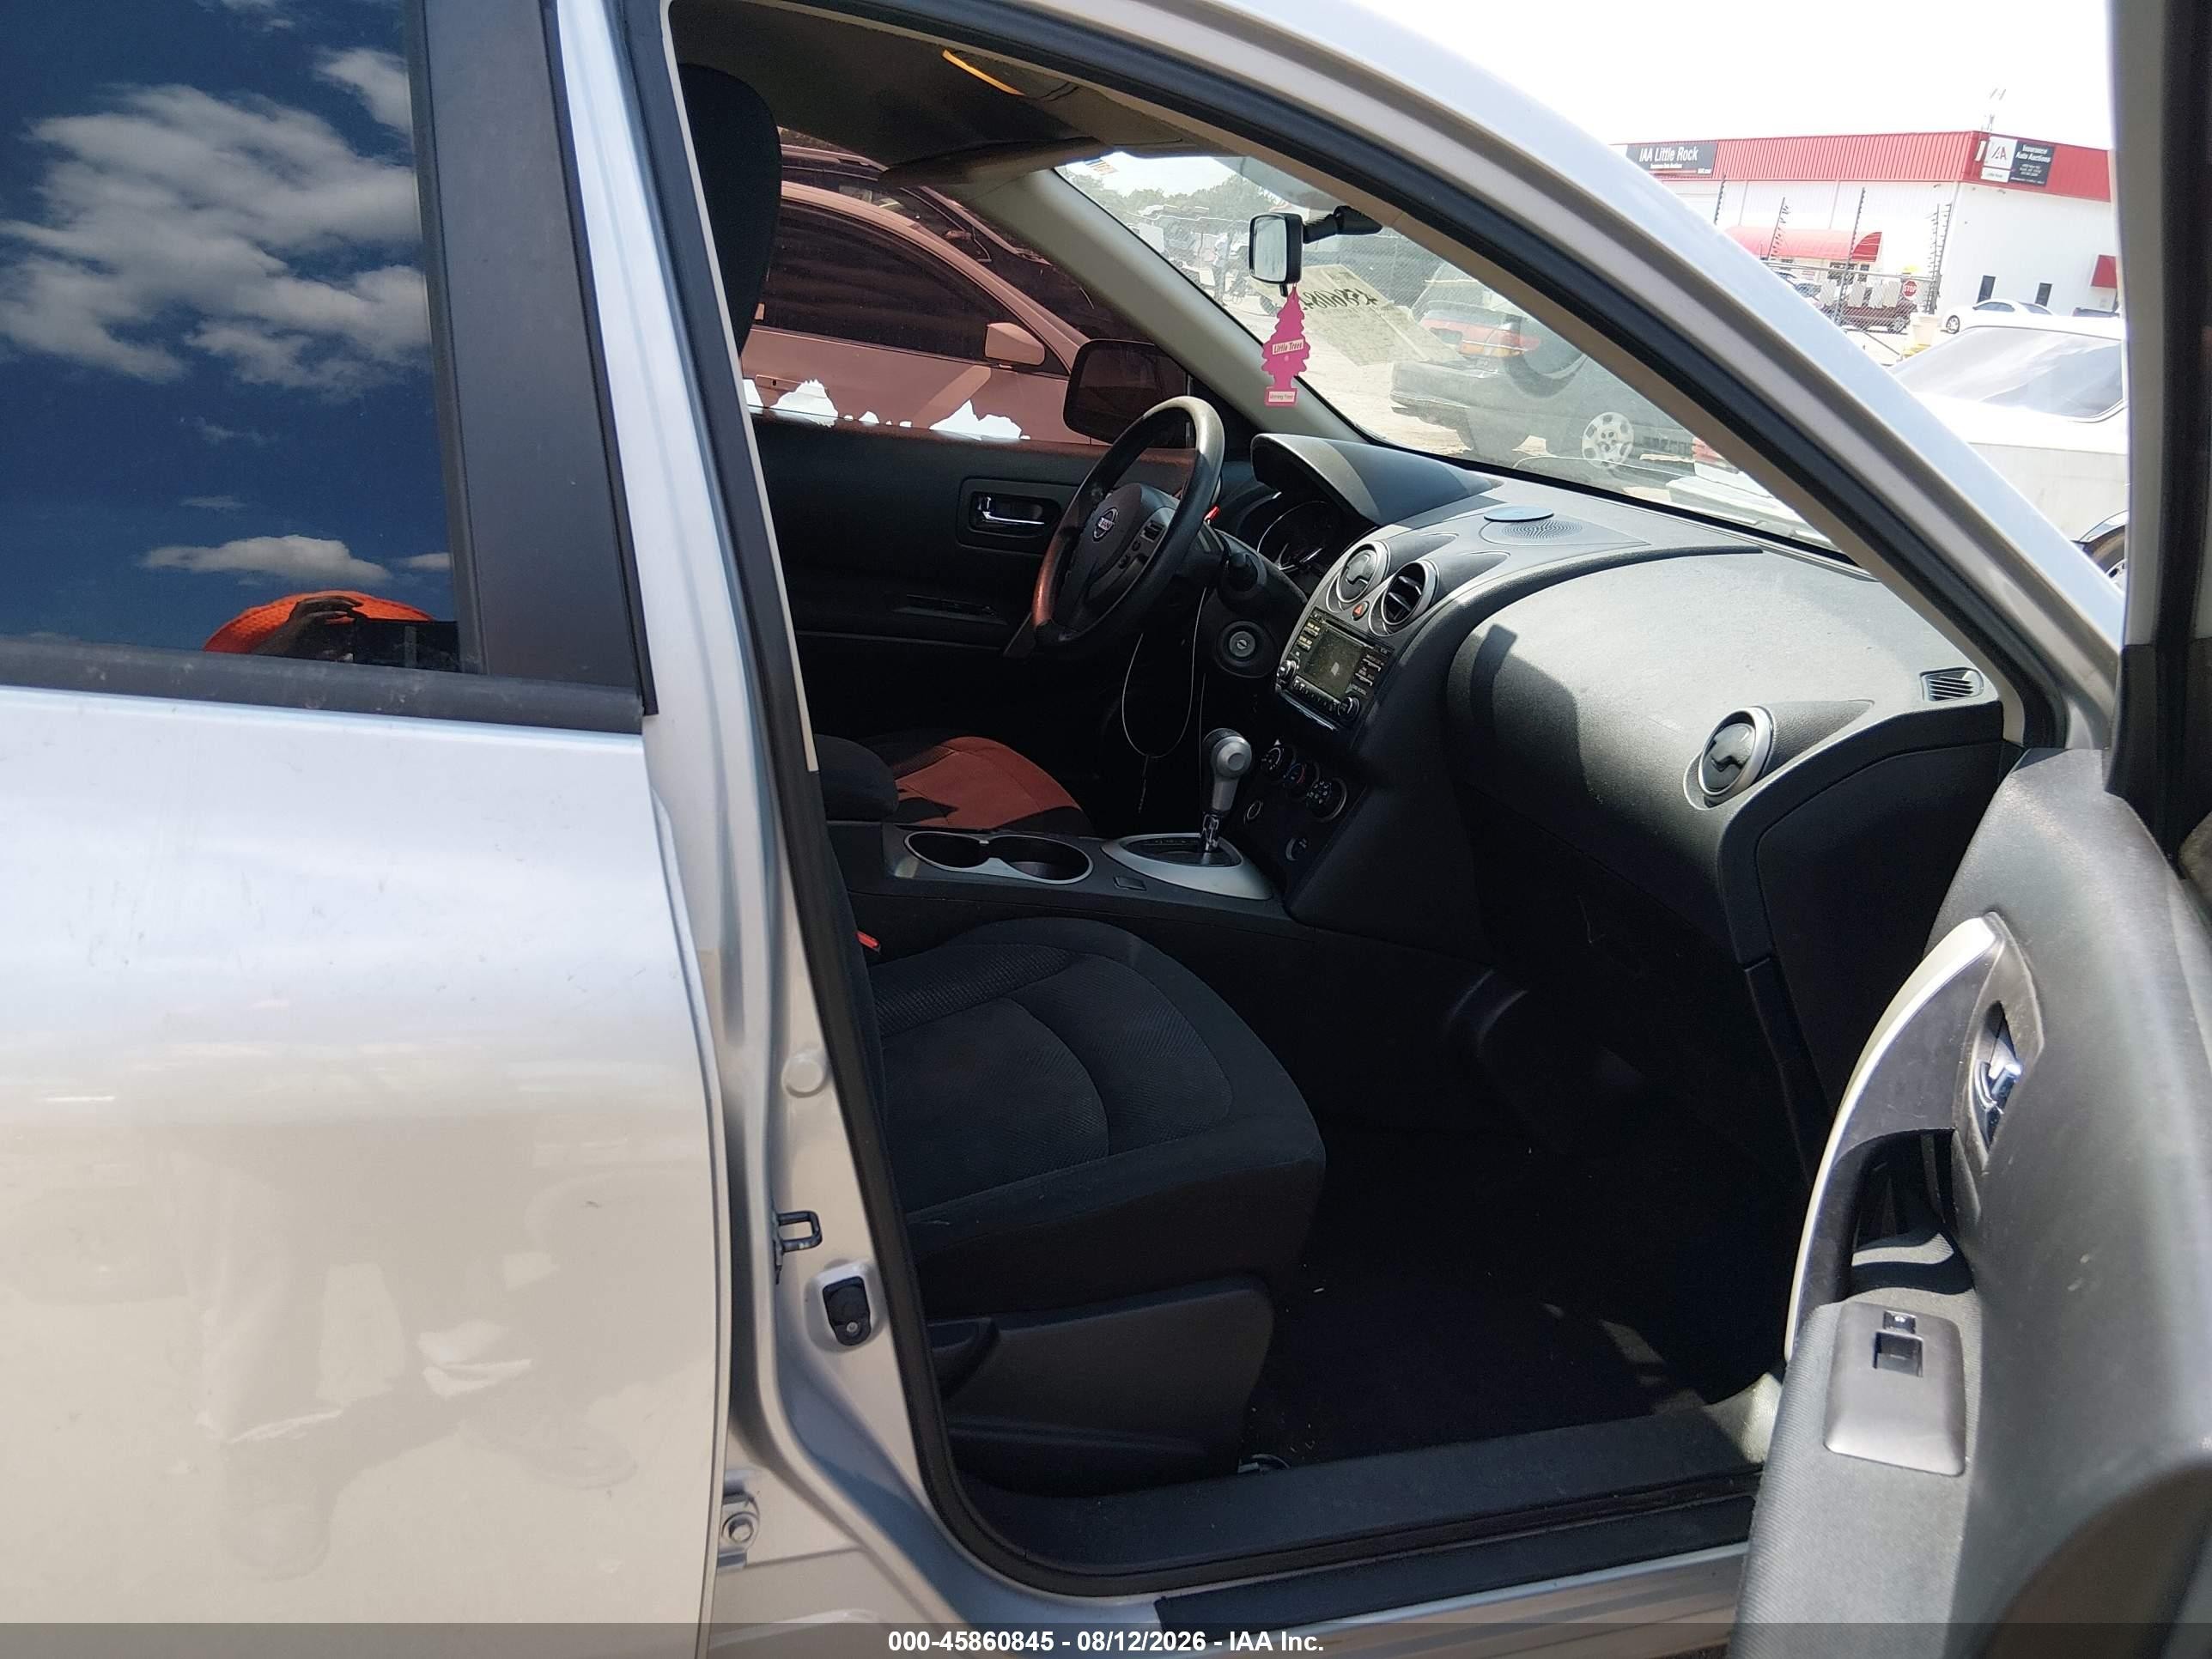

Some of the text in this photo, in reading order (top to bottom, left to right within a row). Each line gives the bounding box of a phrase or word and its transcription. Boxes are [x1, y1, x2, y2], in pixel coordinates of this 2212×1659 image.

[1639, 146, 1698, 161] IAA Little Rock
[1273, 341, 1303, 354] Little Trees
